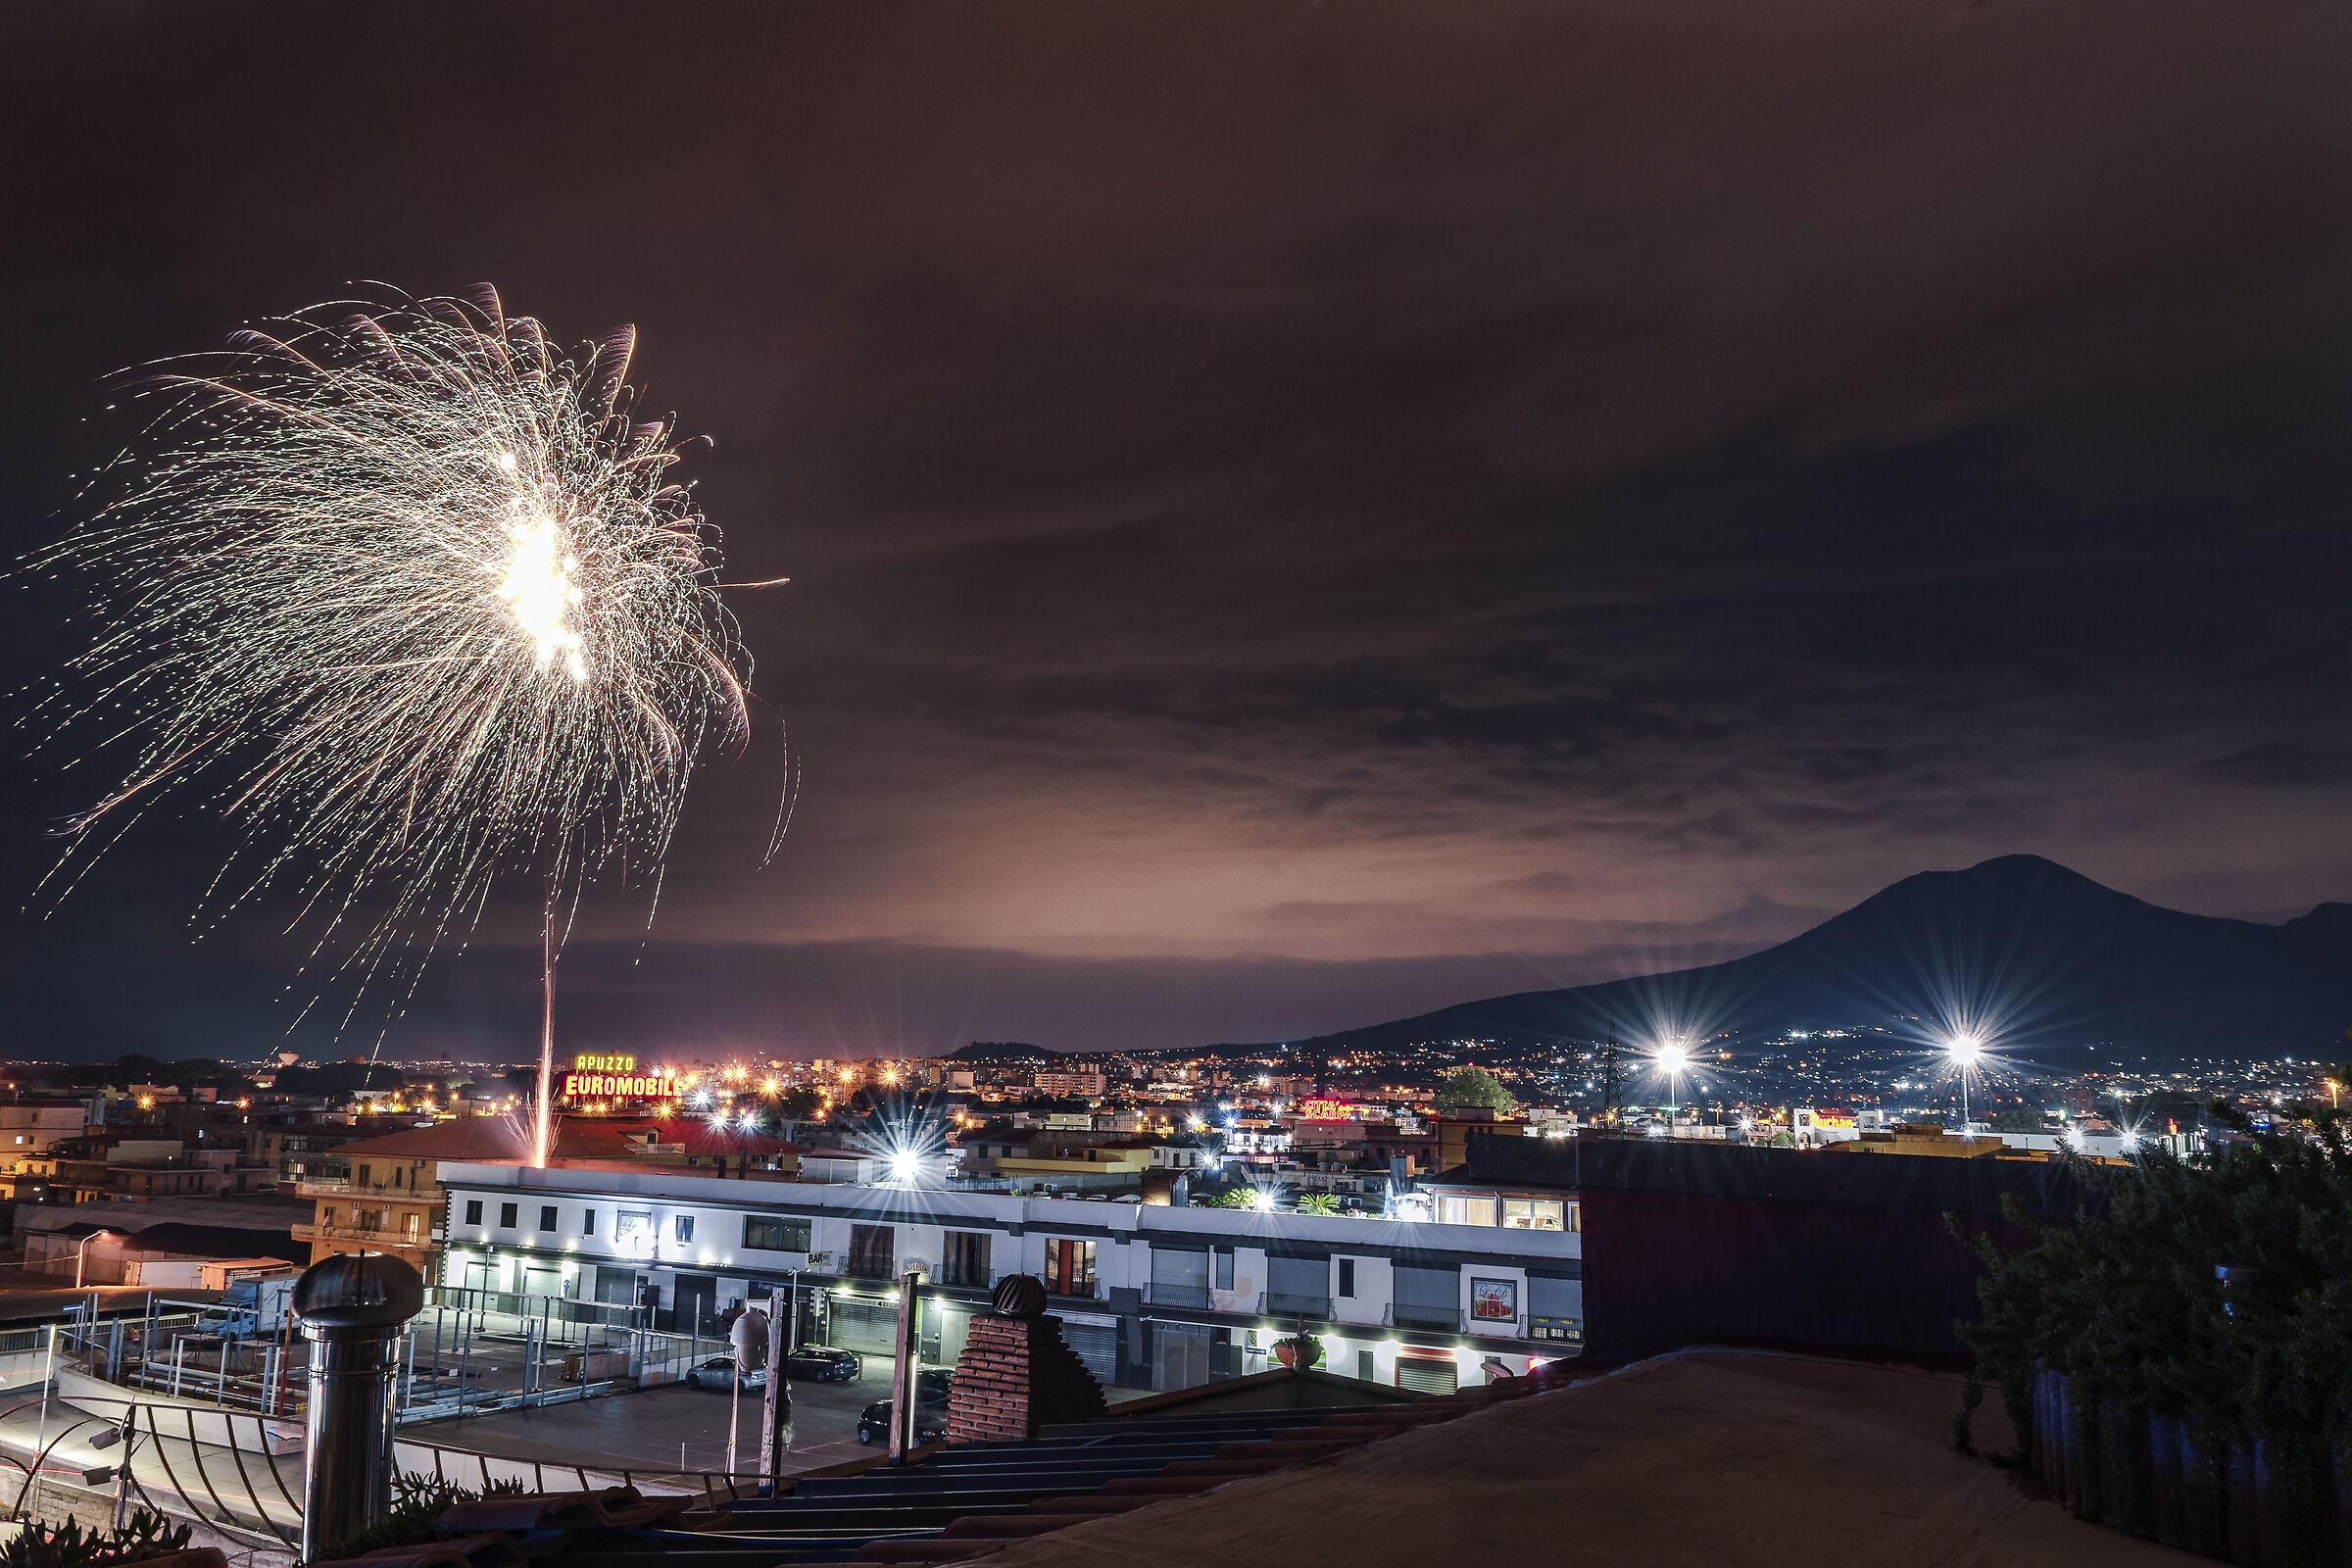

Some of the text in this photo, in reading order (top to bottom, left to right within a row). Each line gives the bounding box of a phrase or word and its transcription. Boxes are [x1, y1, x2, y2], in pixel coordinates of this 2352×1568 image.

[577, 1055, 634, 1071] APUZZO
[1304, 1109, 1353, 1120] SCARPA
[1809, 1111, 1853, 1129] Auchan
[808, 1253, 823, 1264] BAR
